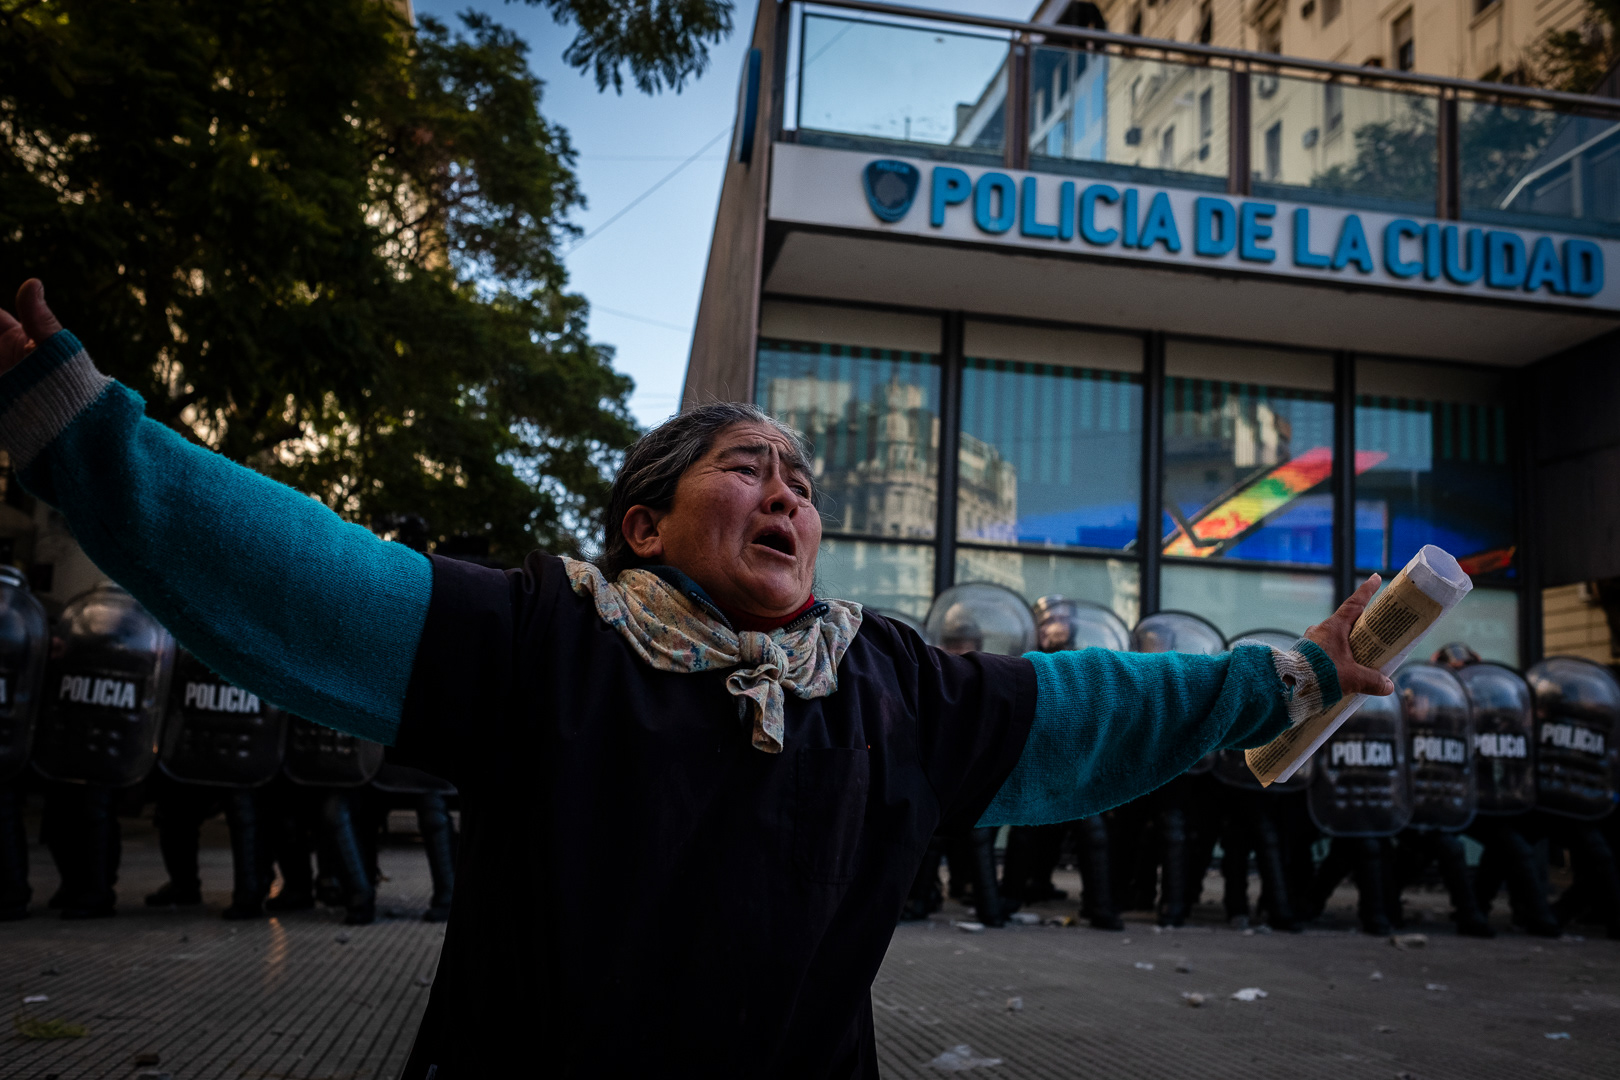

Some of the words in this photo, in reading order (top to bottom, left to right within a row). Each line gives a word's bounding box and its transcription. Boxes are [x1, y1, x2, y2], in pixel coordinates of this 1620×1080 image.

[928, 165, 1182, 253] POLICIA
[1195, 196, 1276, 262] DE
[1293, 208, 1374, 273] LA
[1384, 218, 1605, 297] CIUDAD
[59, 674, 136, 709] POLICIA
[185, 681, 260, 714] POLICIA
